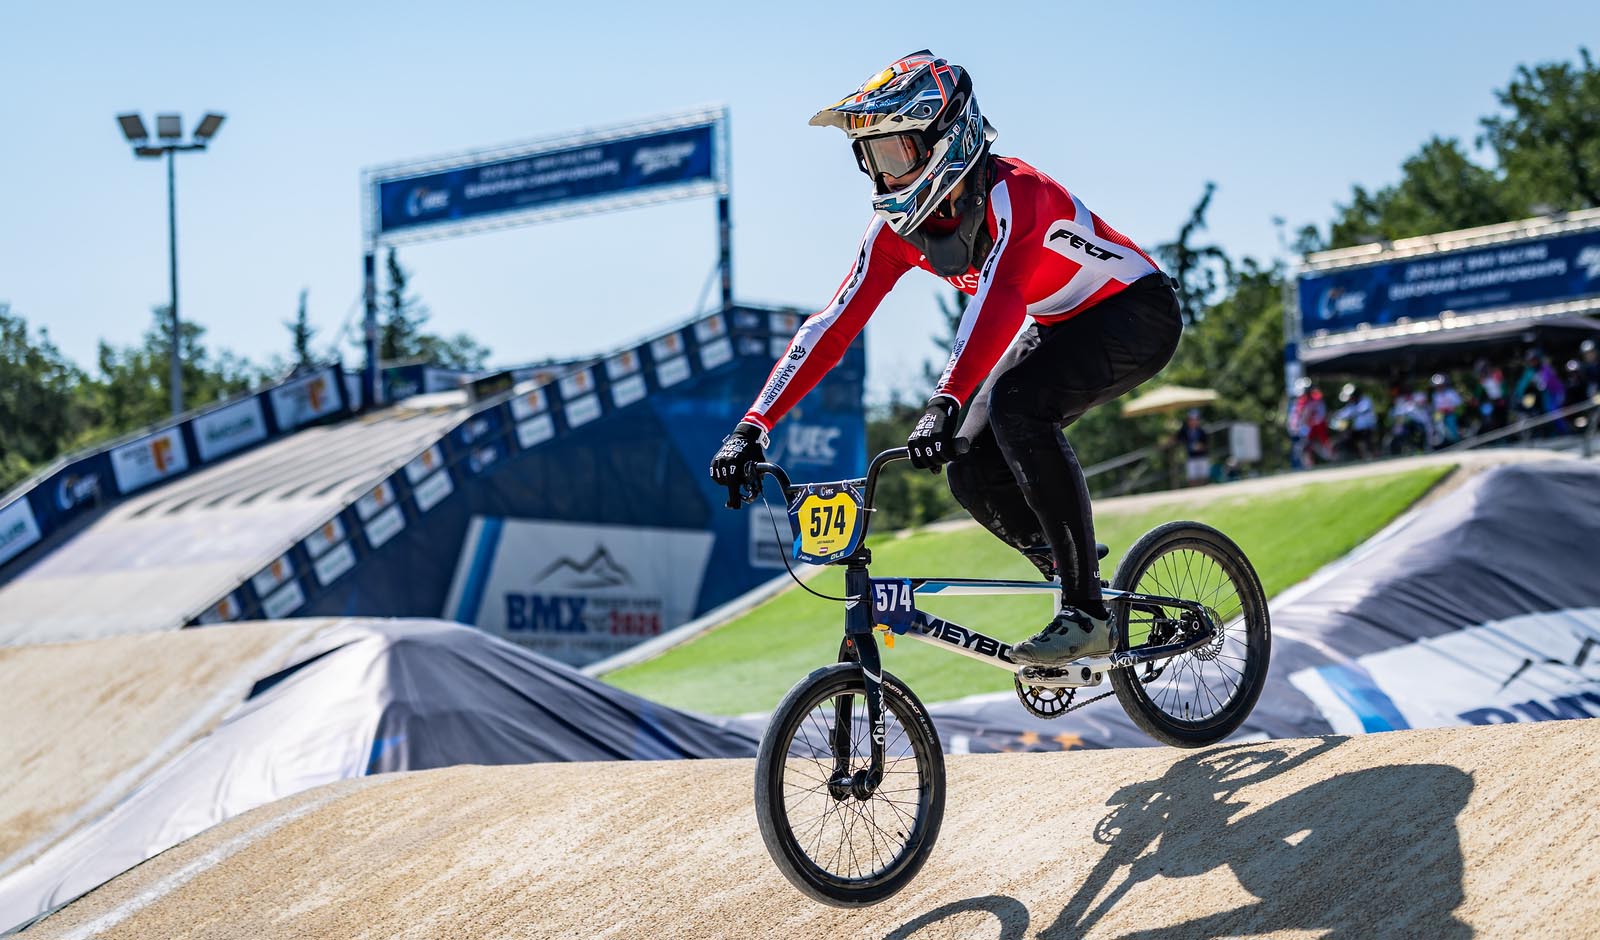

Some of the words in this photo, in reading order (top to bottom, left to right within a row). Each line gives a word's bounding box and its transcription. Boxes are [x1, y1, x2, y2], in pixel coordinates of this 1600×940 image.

[1049, 229, 1124, 261] FELT
[1459, 258, 1568, 290] CHAMPIONSHIPS
[763, 363, 797, 406] SAALFELDEN
[788, 424, 842, 458] UEC
[810, 505, 846, 538] 574
[507, 594, 588, 632] BMX
[874, 583, 912, 612] 574
